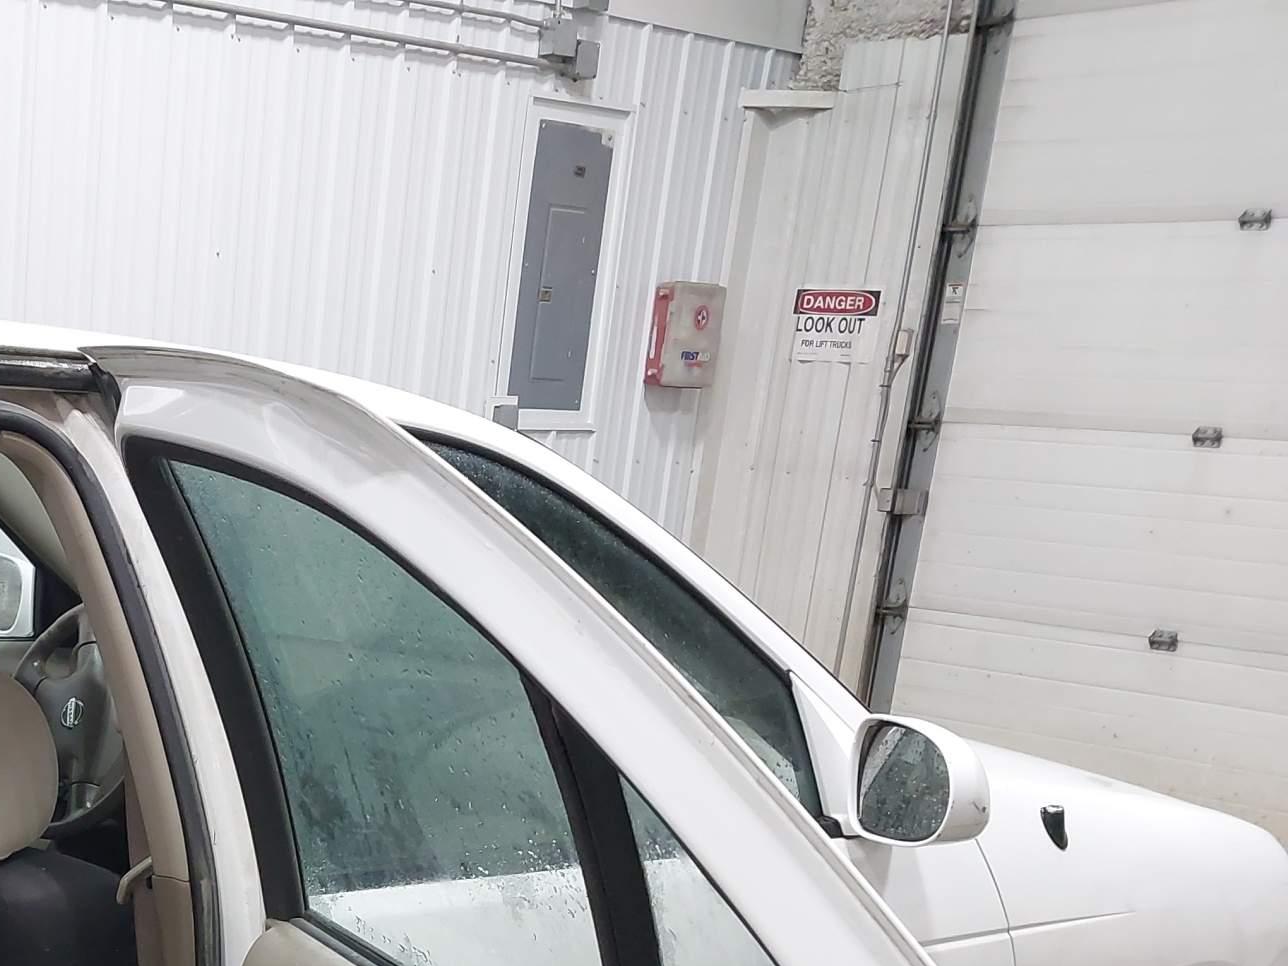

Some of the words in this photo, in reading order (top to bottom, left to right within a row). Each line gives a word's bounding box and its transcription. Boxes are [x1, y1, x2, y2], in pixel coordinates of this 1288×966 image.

[803, 296, 865, 310] DANGER
[796, 316, 836, 334] LOOK
[838, 317, 866, 334] OUT
[801, 339, 815, 348] FOR
[815, 340, 829, 349] LIFT
[829, 341, 852, 349] TRUCKS
[680, 351, 700, 361] FIRST
